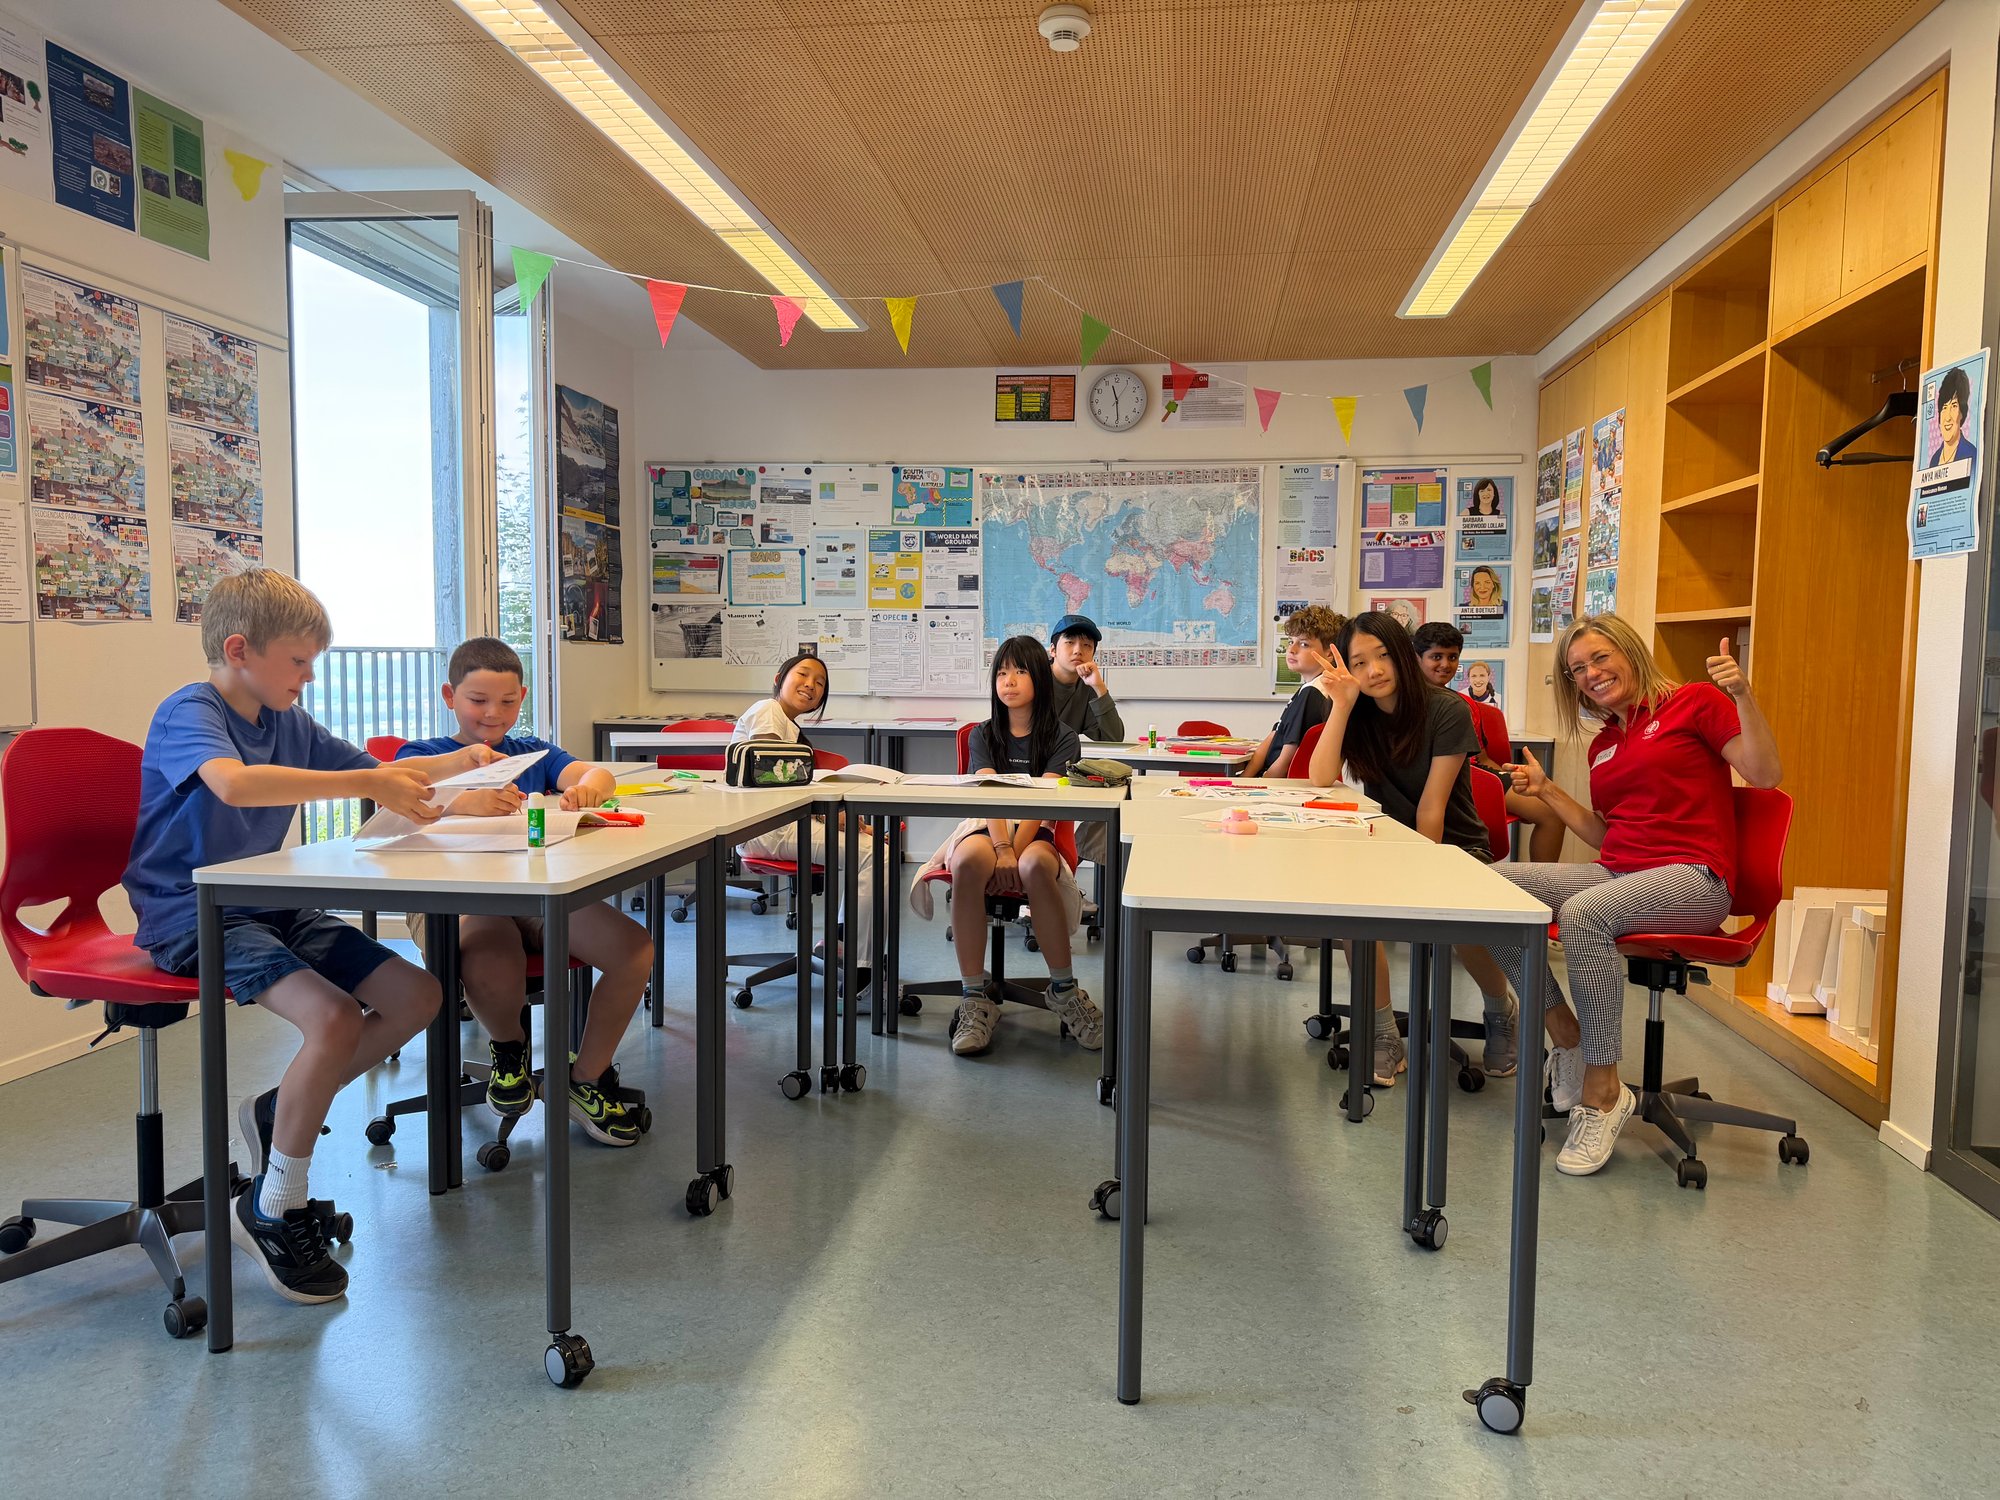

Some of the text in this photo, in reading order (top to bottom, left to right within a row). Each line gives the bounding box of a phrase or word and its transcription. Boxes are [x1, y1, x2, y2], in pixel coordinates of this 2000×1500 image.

[693, 469, 738, 481] CORAL
[1921, 472, 1934, 484] ANYA
[720, 500, 757, 510] REEFS
[750, 552, 781, 562] SAND
[1289, 550, 1324, 562] BRICS
[819, 636, 844, 644] Caves
